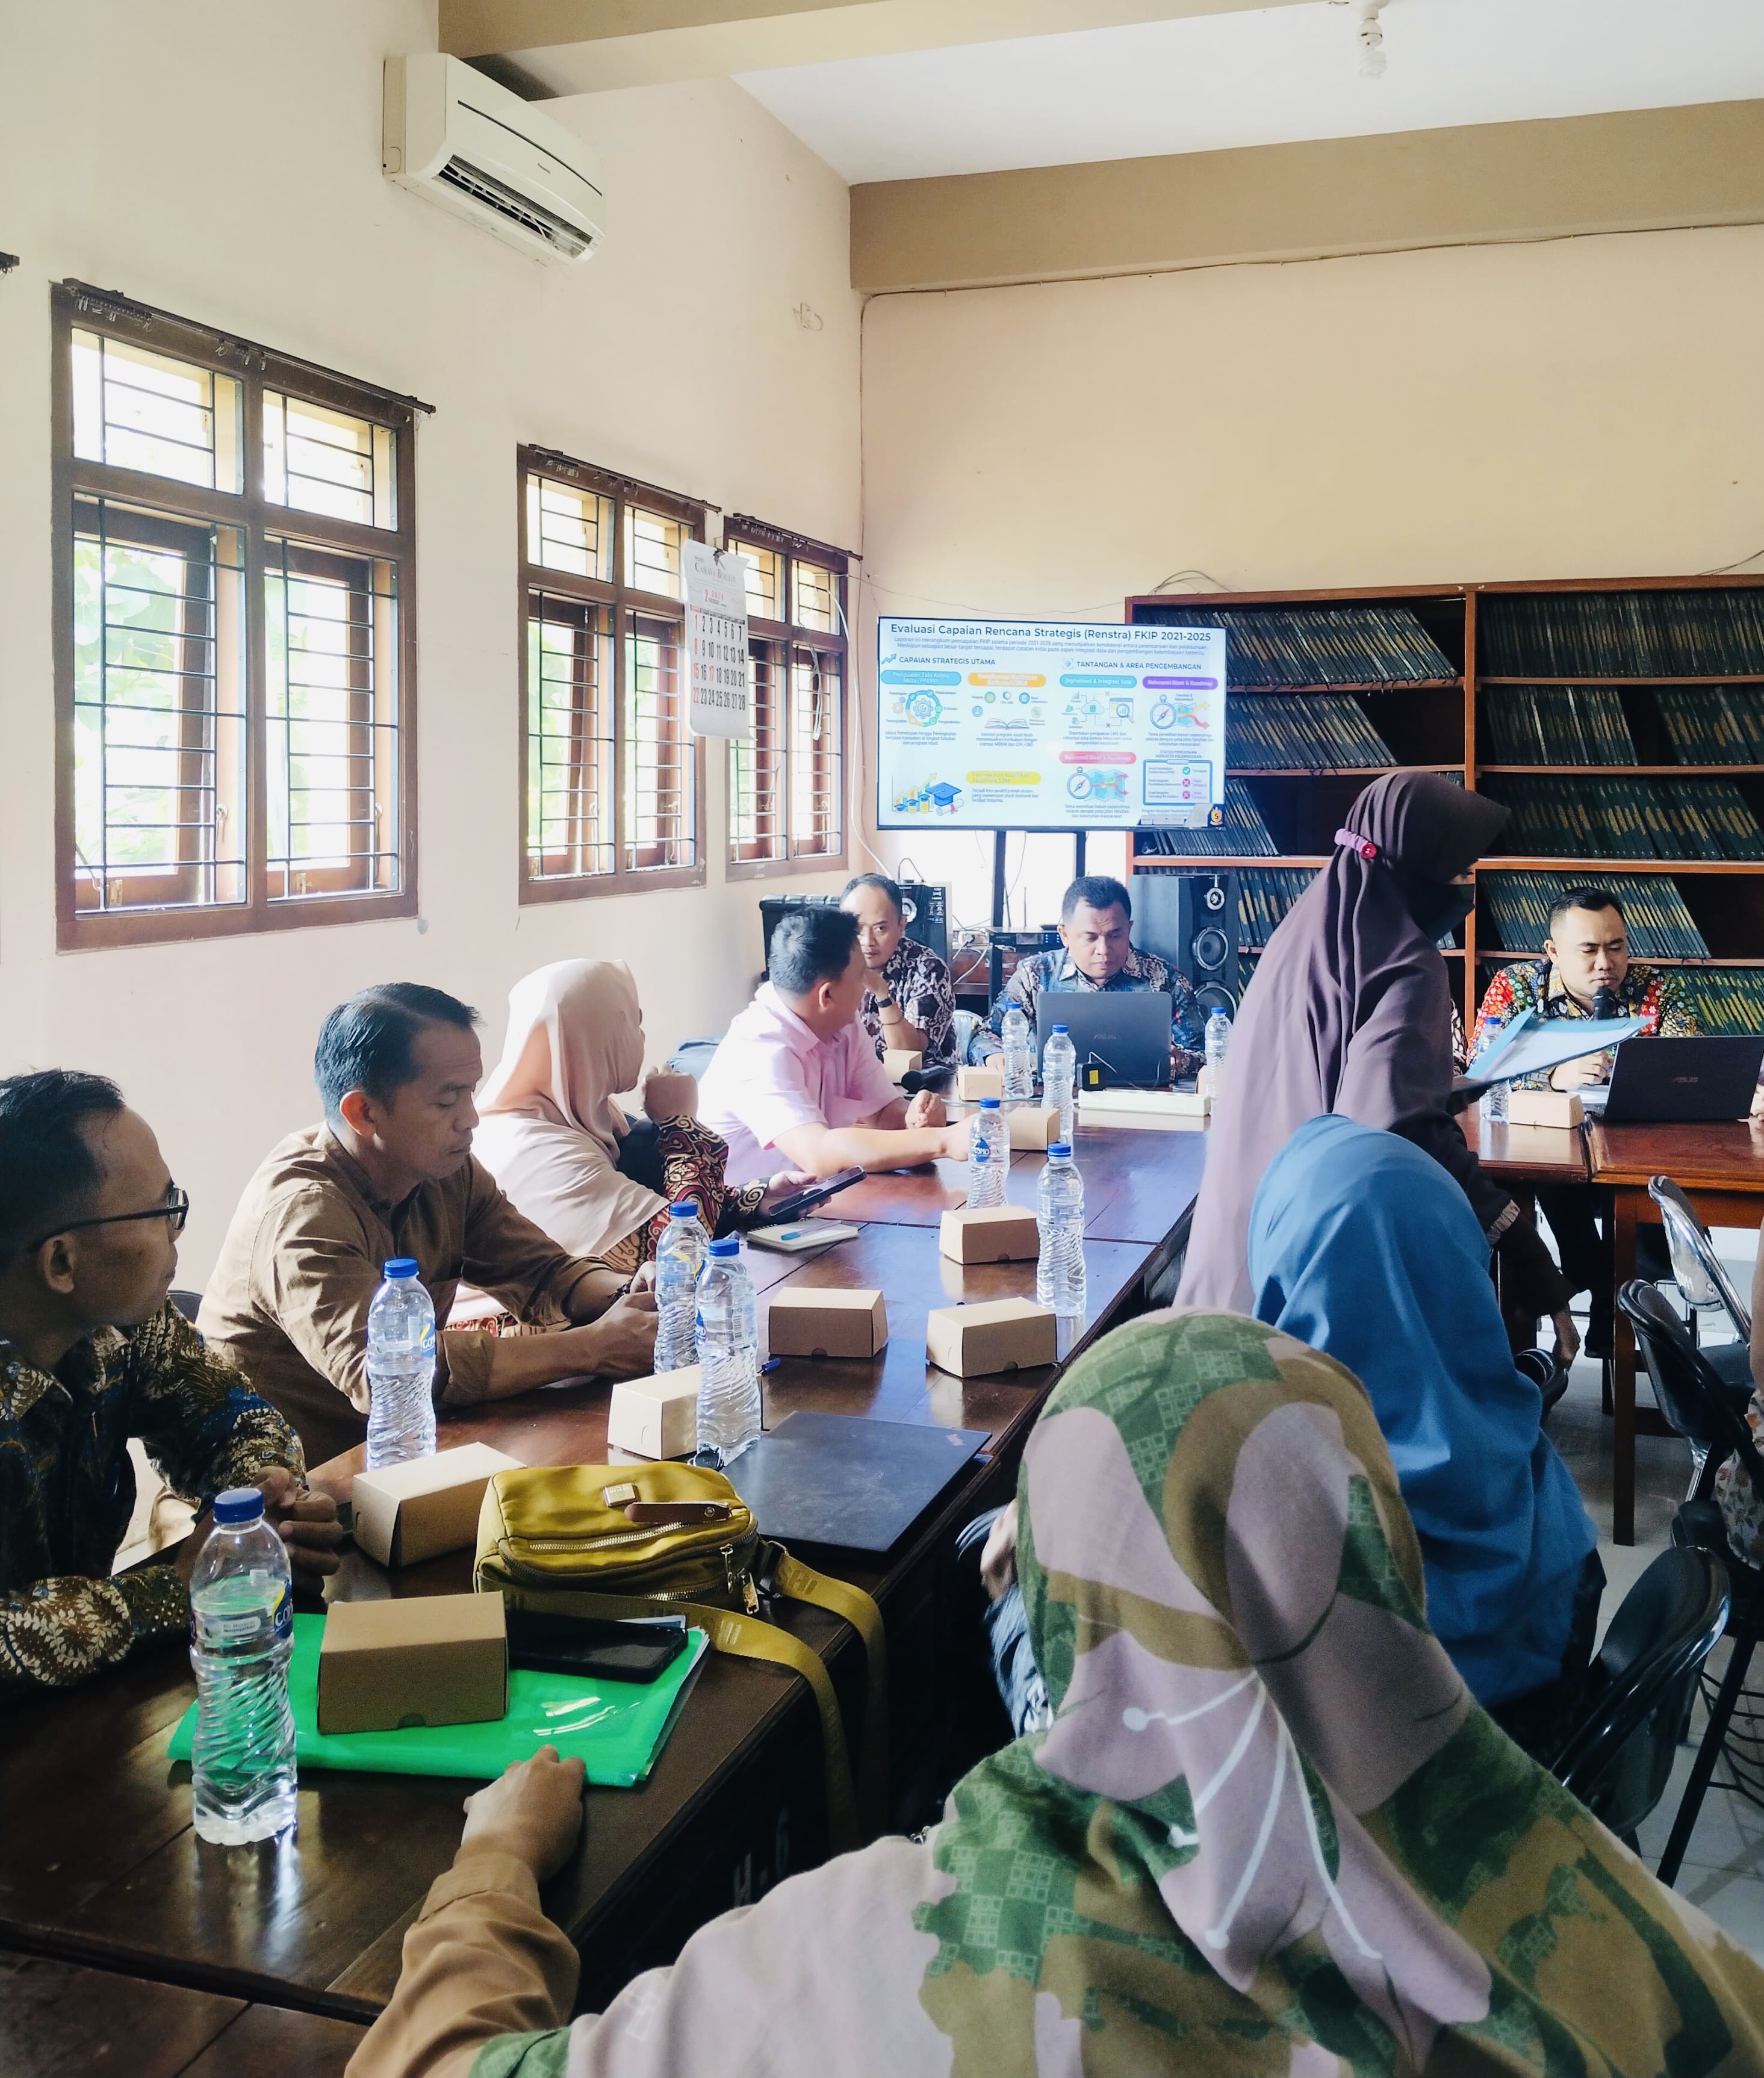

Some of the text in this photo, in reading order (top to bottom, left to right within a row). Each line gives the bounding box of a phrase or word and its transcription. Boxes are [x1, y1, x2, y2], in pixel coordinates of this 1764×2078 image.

[705, 589, 708, 602] 2
[702, 615, 706, 632] 2
[710, 617, 713, 634] 3
[717, 620, 720, 636] 4
[724, 621, 727, 637] 5
[731, 624, 734, 639] 6
[739, 625, 742, 641] 7
[891, 624, 1211, 641] Evaluasi Capaian Rencana Strategis (Renstra) FKIP 2021-2025
[695, 638, 744, 665] 8 9 10 11 12 13 14
[694, 663, 744, 687] 15 16 17 18 19 20 21
[694, 687, 745, 710] 22 23 24 25 26 27 28
